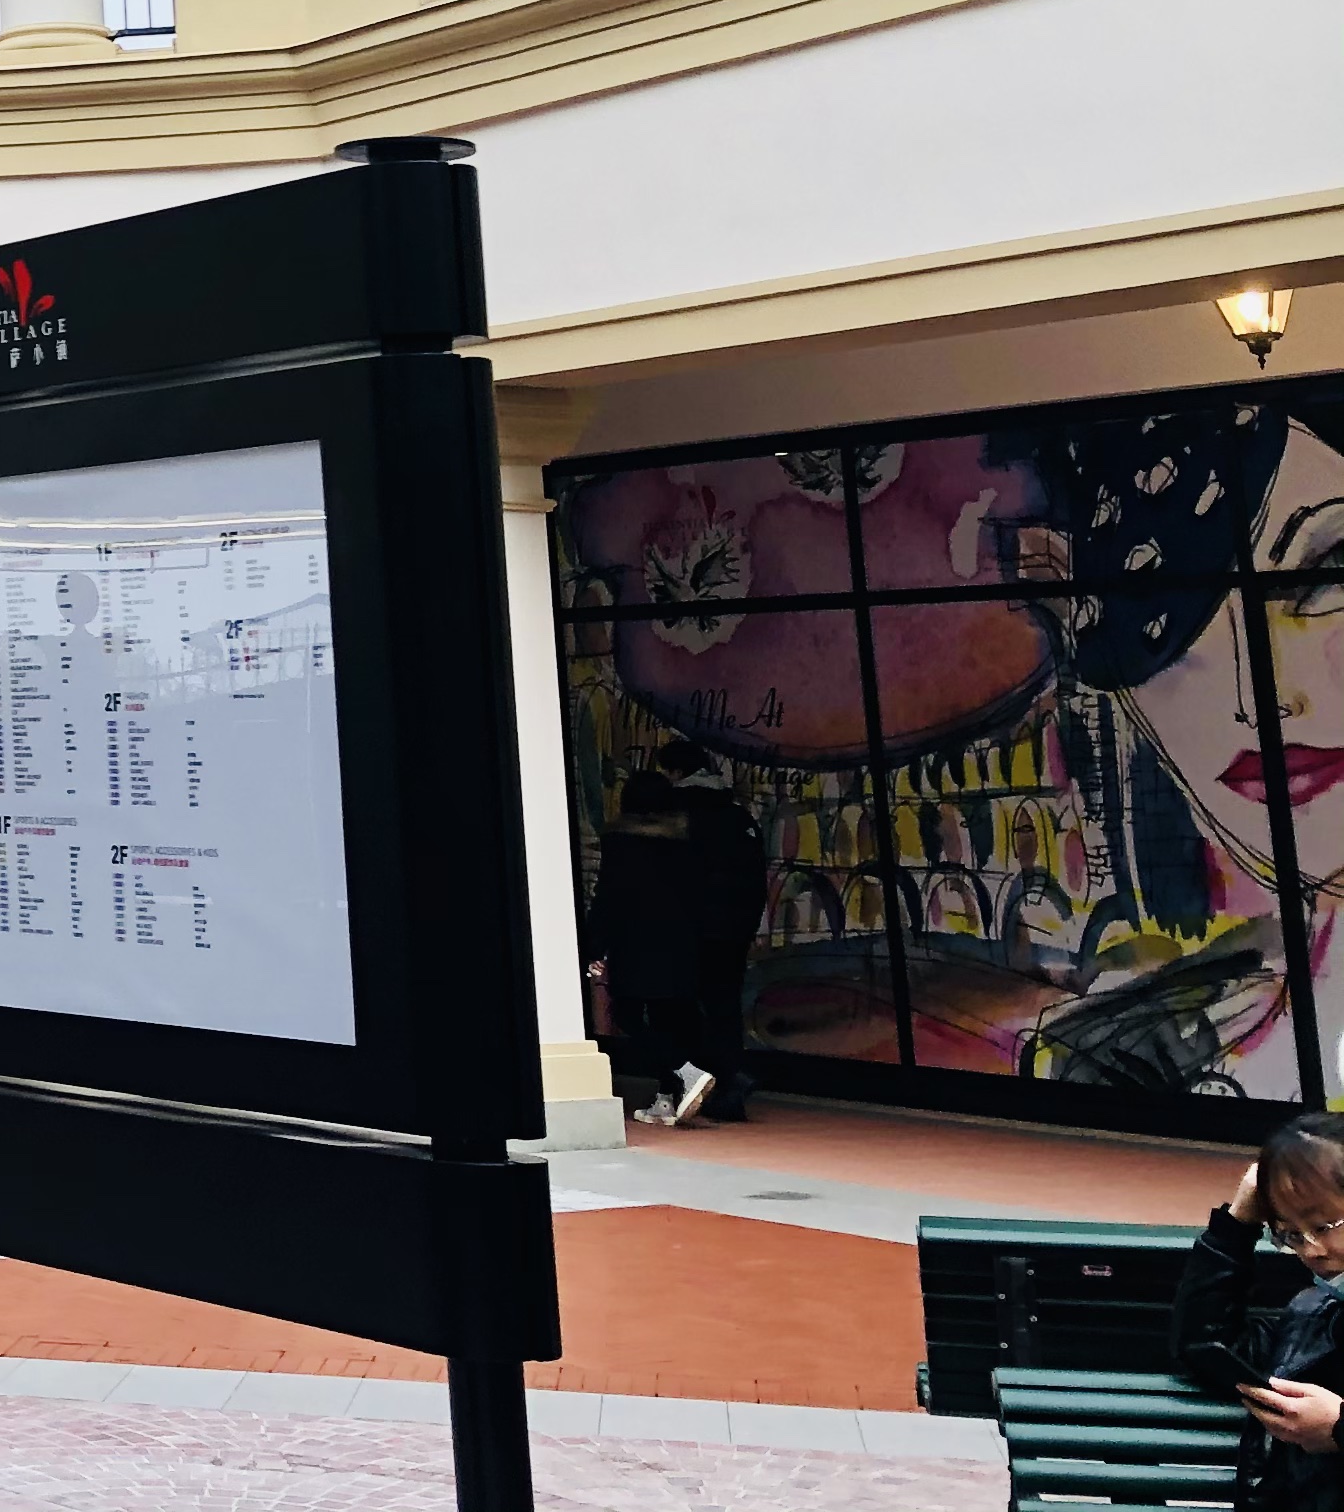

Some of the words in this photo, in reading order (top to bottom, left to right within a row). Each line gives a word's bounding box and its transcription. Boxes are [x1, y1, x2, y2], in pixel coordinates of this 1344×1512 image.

[225, 619, 243, 639] 2F
[105, 692, 121, 712] 2F
[740, 687, 785, 728] At
[111, 844, 128, 865] 2F
